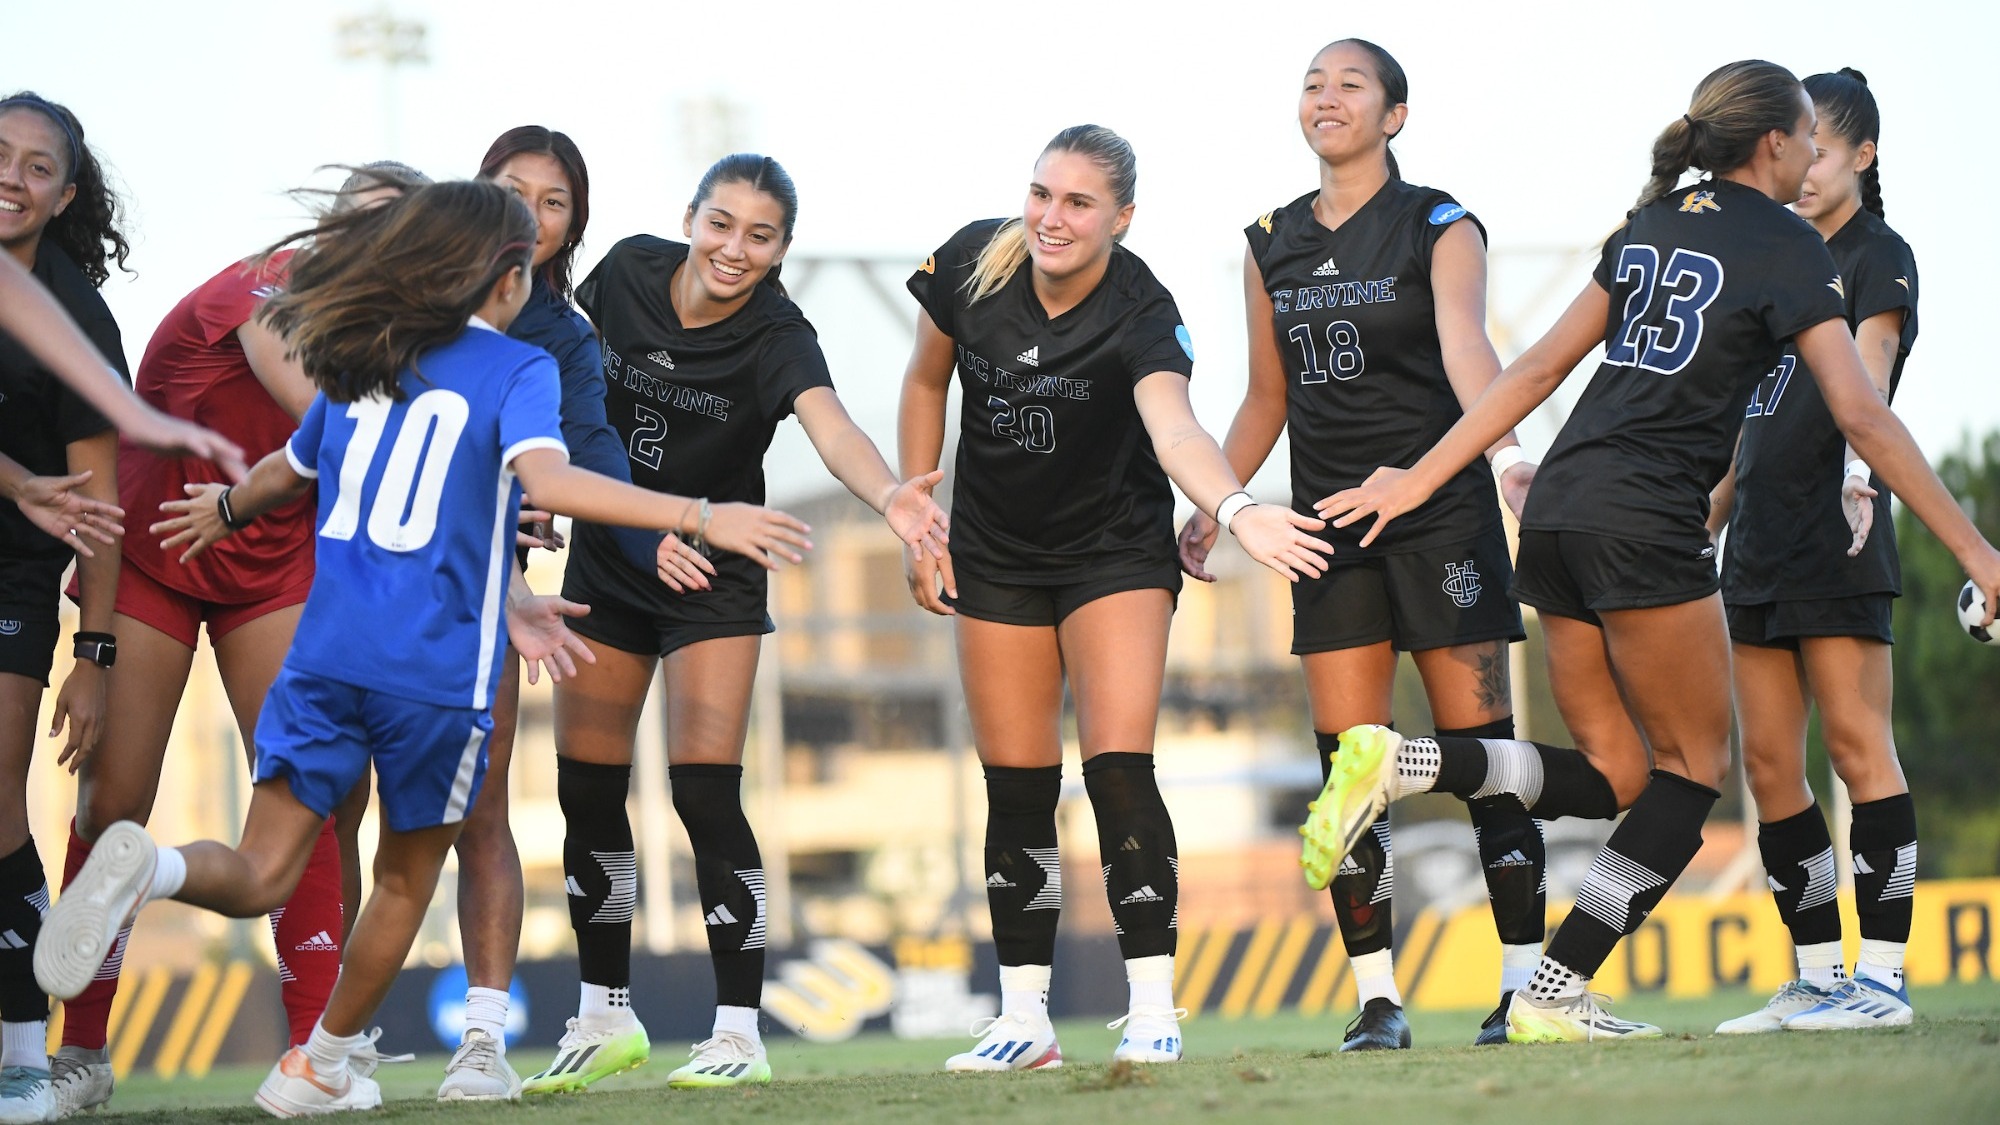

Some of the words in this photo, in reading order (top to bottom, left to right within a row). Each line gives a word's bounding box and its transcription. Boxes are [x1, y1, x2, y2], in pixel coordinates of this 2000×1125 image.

[1295, 277, 1397, 311] IRVINE
[1602, 244, 1724, 375] 23
[646, 352, 676, 371] adidas
[958, 344, 989, 382] UC
[994, 367, 1090, 400] IRVINE
[1288, 320, 1365, 384] 18
[623, 365, 730, 422] IRVINE
[629, 404, 668, 471] 2
[987, 395, 1056, 453] 20
[318, 388, 470, 552] 10
